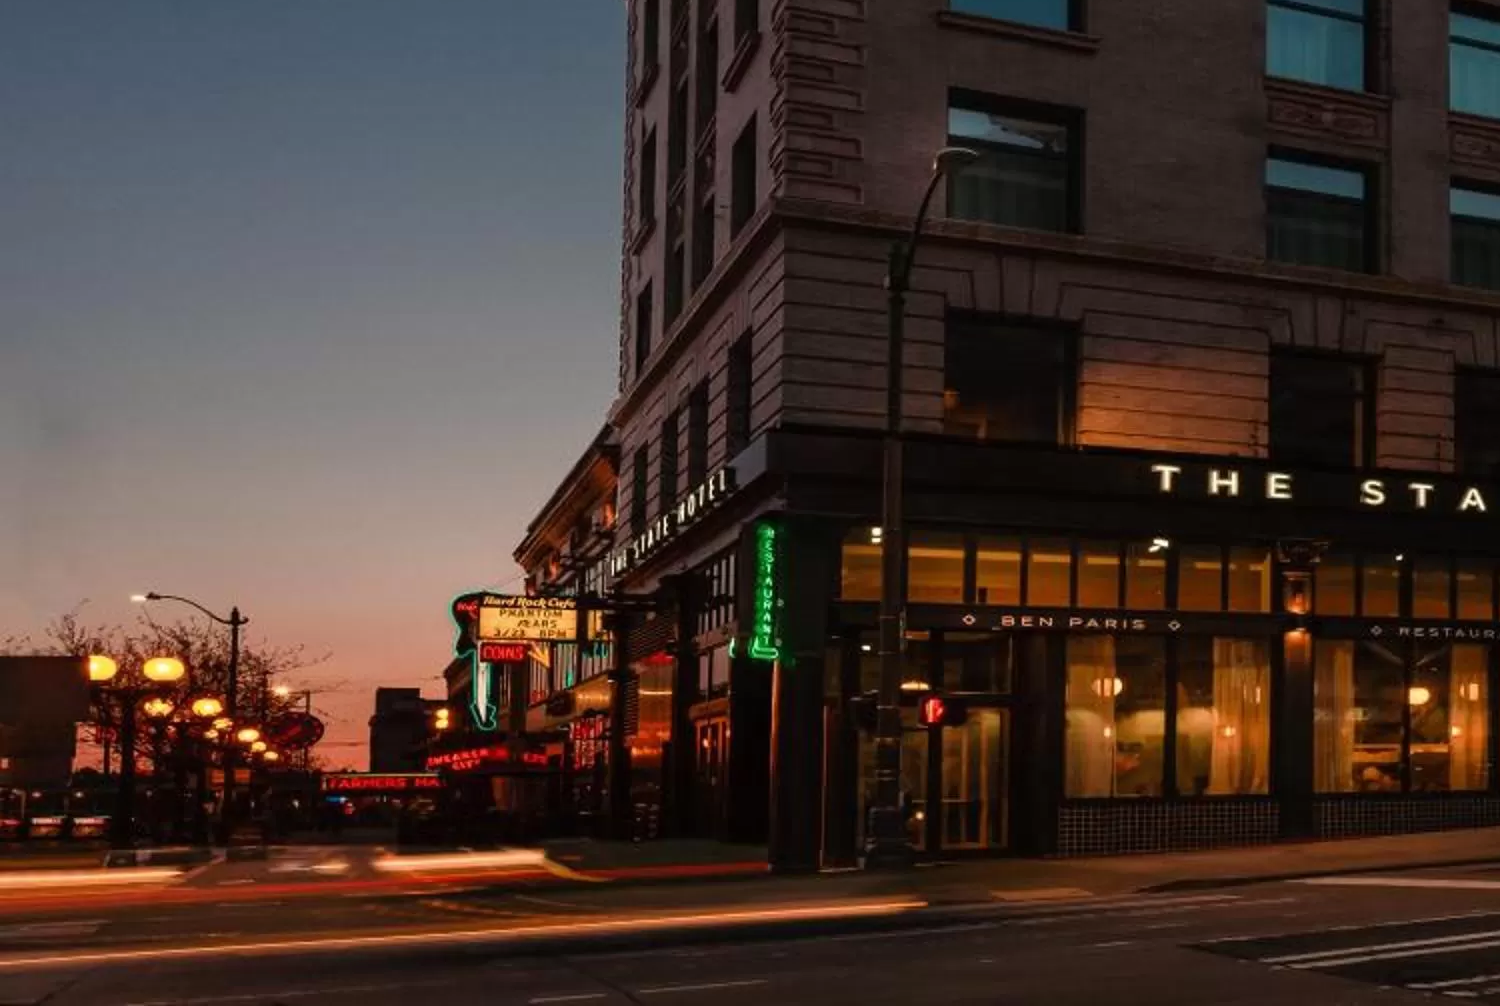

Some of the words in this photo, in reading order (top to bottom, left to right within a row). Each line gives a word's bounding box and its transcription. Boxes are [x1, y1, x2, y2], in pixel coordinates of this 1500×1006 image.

[1151, 464, 1293, 499] THE
[633, 513, 670, 560] STATE
[677, 468, 726, 525] HOTEL
[763, 526, 775, 645] RESTAURANT
[483, 595, 516, 605] Hard
[517, 597, 546, 609] Rock
[547, 597, 577, 609] Cafe
[499, 609, 562, 618] PHANTOM
[1000, 614, 1054, 627] BEN
[1069, 616, 1147, 630] PARIS
[482, 645, 525, 660] COINS
